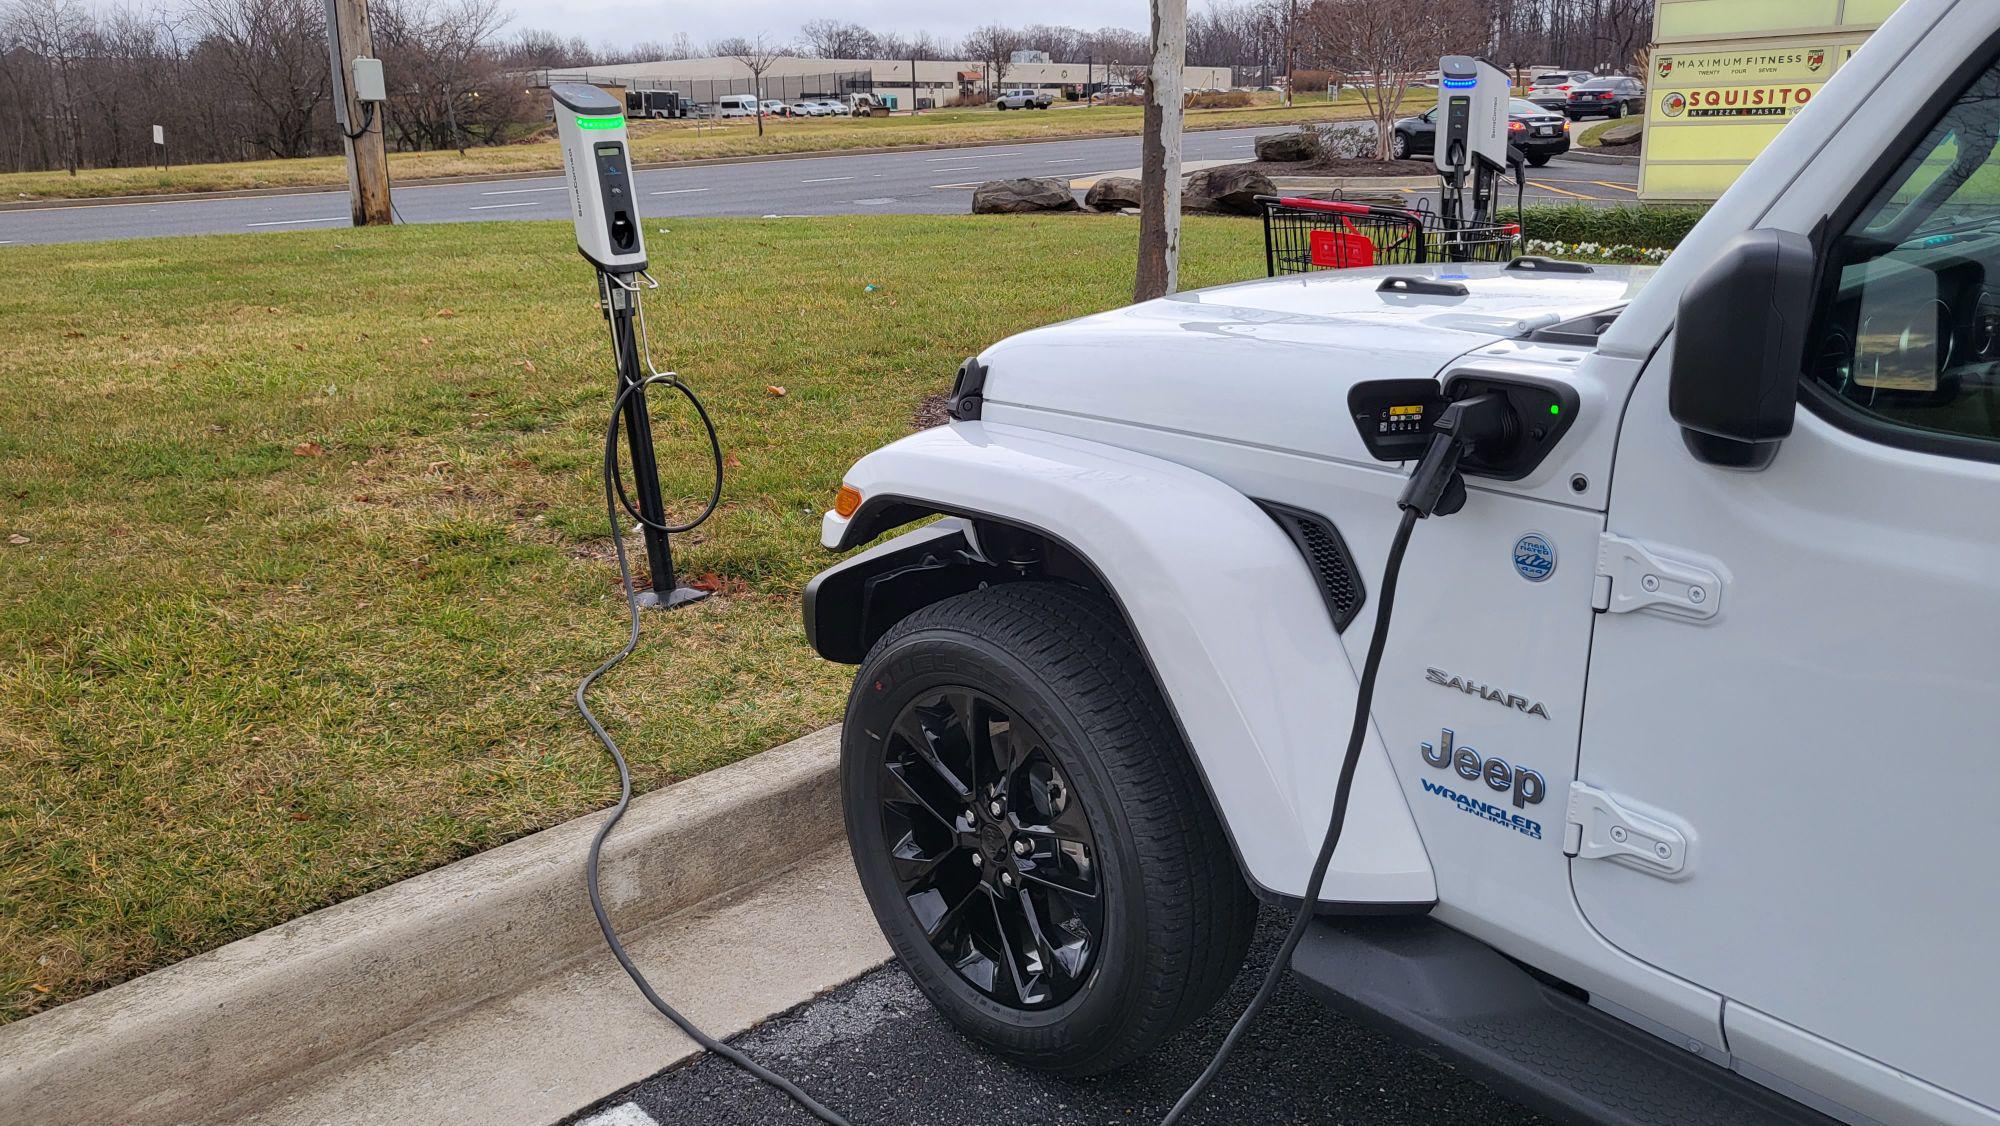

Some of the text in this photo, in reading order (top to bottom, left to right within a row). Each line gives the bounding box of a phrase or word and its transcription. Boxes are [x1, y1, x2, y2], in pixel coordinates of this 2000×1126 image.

[1677, 58, 1742, 69] MAXIMUM
[1746, 54, 1802, 66] FITNESS
[1689, 87, 1812, 107] SQUISITO
[1424, 666, 1552, 721] SAHARA
[1421, 727, 1546, 809] Jeep
[1420, 778, 1542, 834] WRANGLER
[1457, 803, 1542, 840] UNLIMITED
